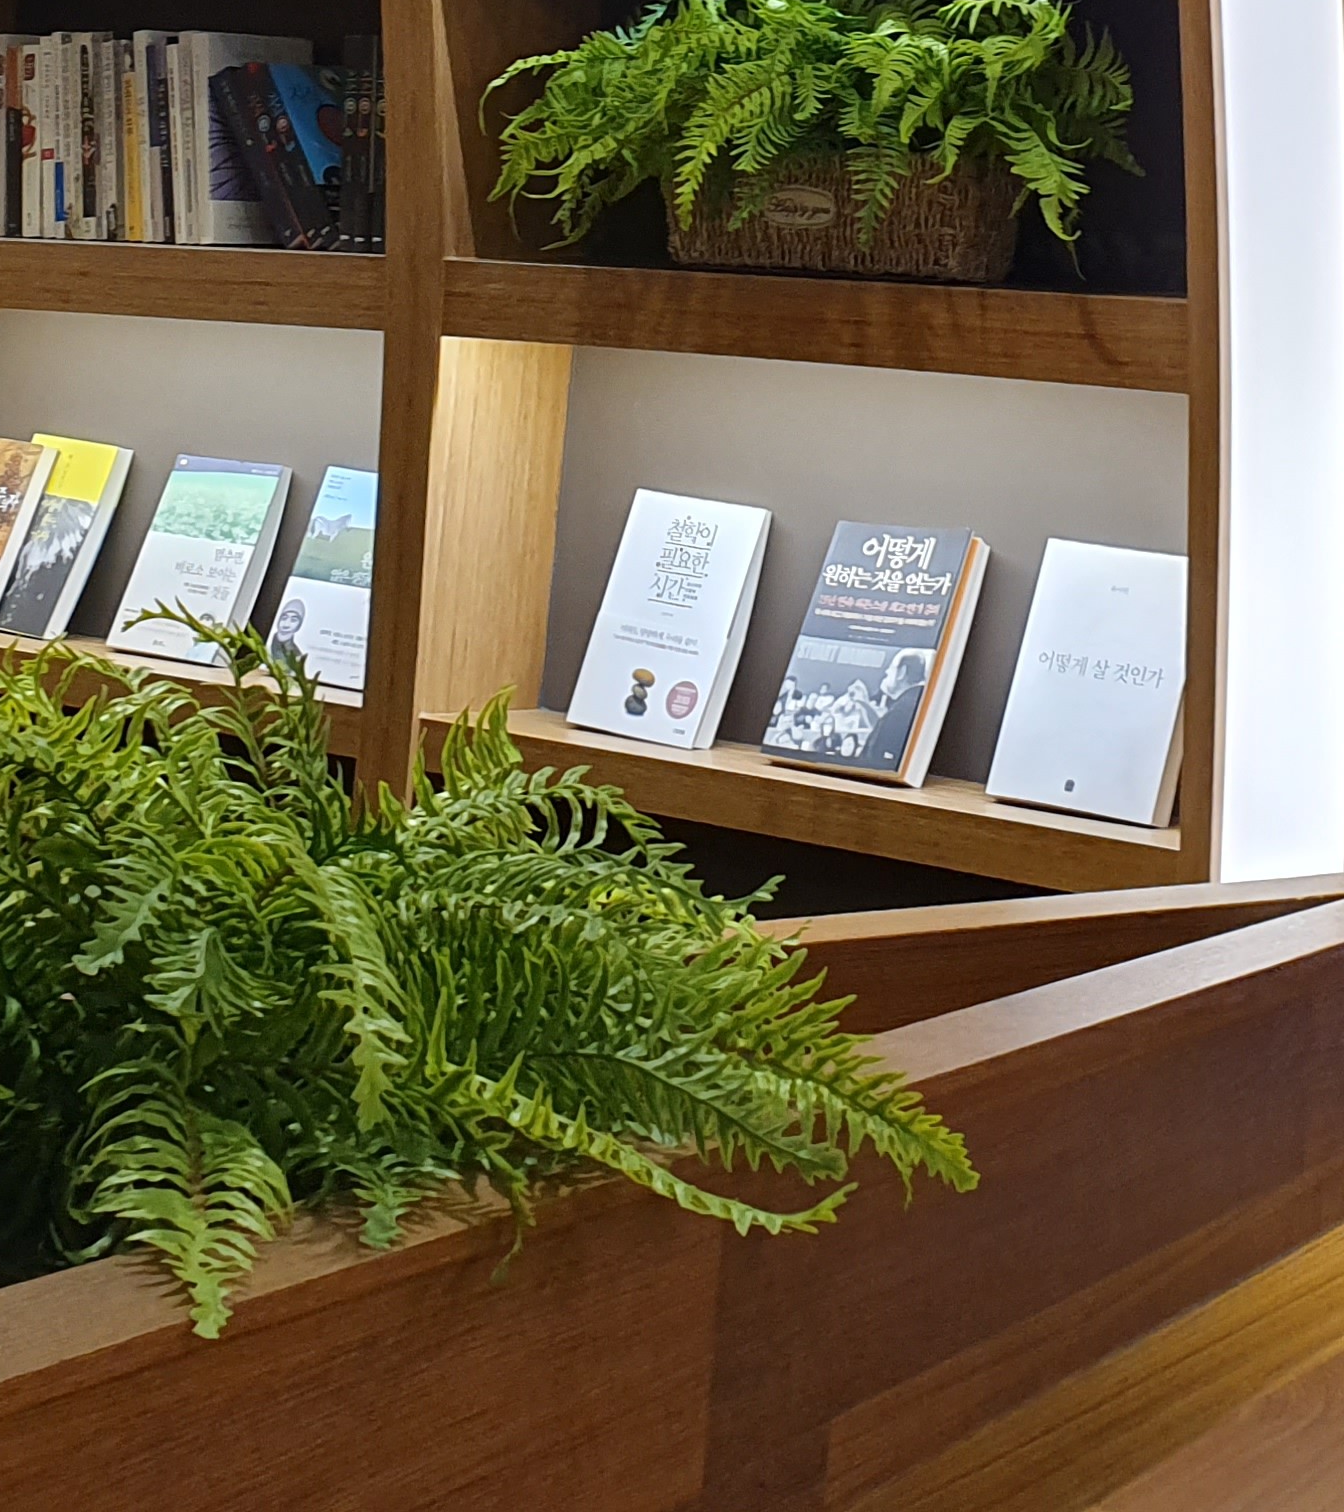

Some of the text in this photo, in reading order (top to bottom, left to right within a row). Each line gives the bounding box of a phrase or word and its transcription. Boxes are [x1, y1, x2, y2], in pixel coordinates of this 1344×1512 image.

[667, 516, 718, 548] 철학이
[659, 546, 710, 576] 필요한
[862, 534, 936, 570] 어떻게
[649, 574, 686, 601] 시간
[822, 563, 872, 590] 원하는
[872, 569, 905, 594] 것을
[1038, 650, 1165, 688] 어떻게 살 것인가
